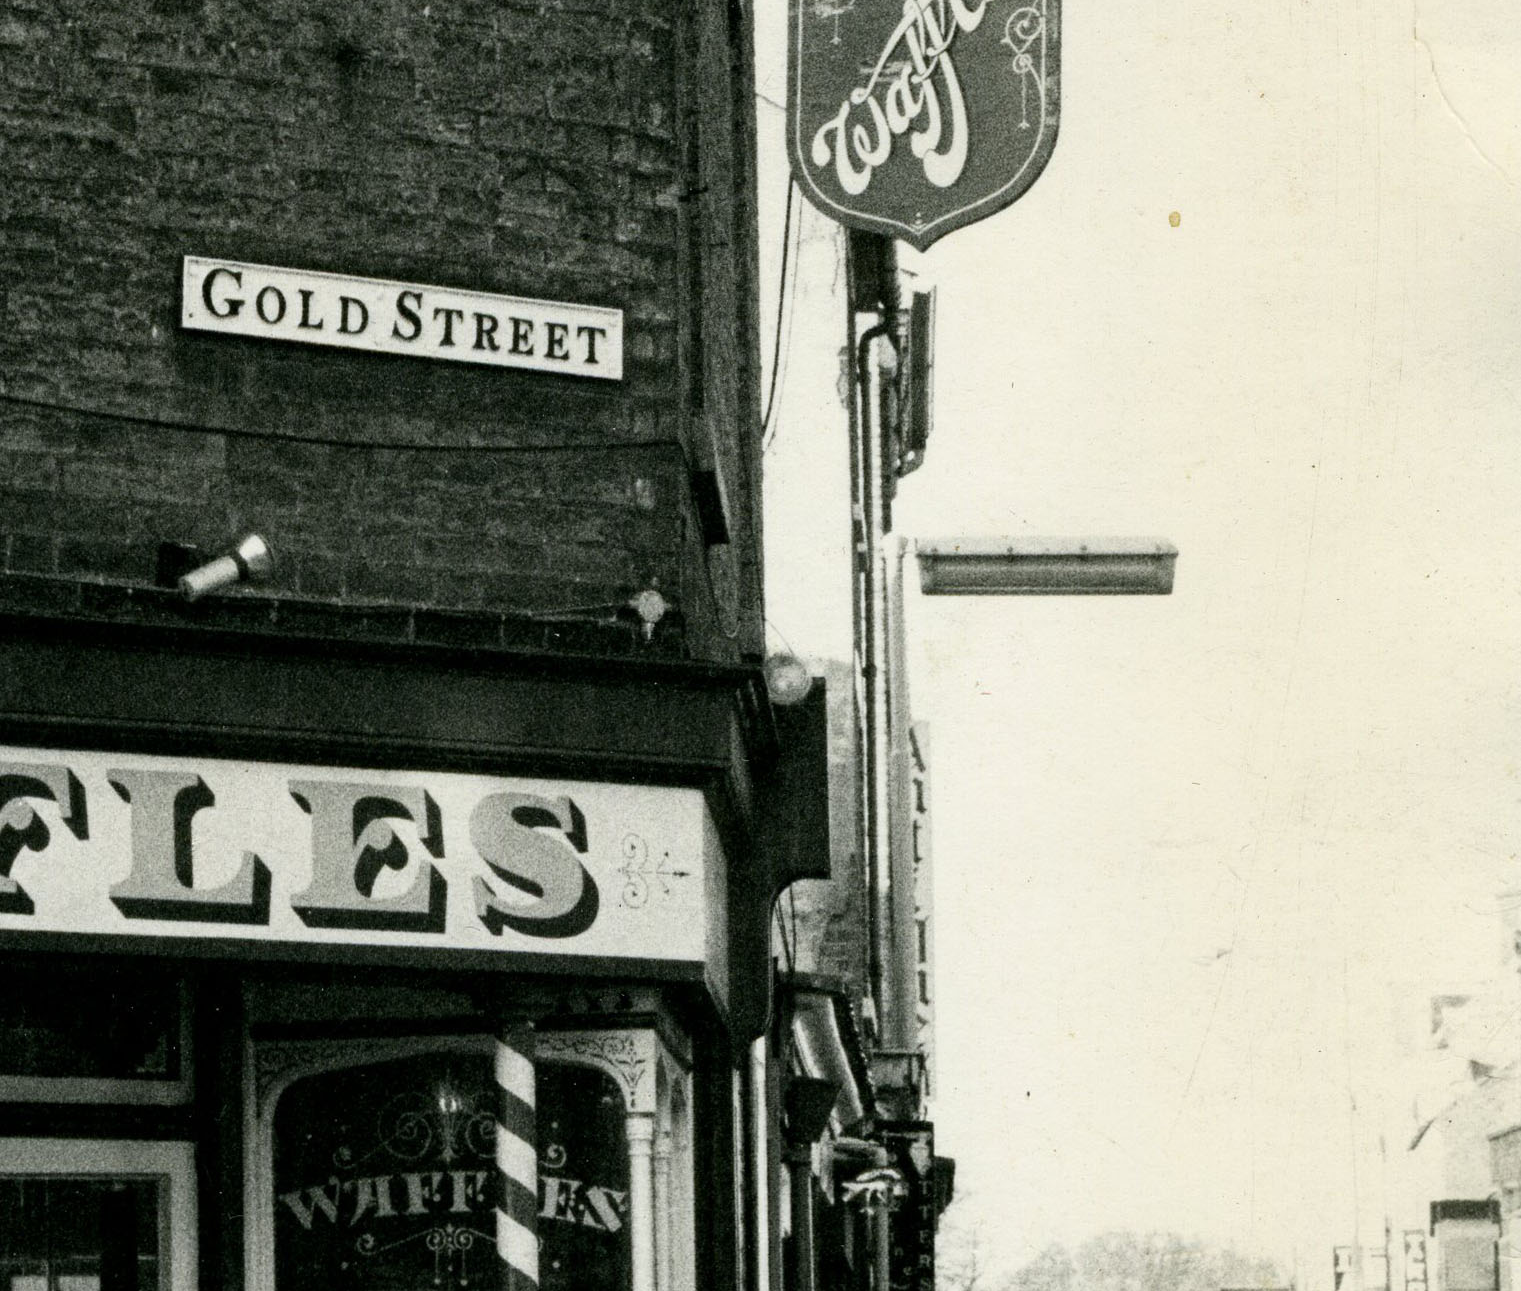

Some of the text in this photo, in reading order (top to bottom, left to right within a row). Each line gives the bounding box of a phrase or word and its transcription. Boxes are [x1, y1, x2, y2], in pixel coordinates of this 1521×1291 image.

[201, 268, 607, 365] GOLD STREET
[278, 1171, 629, 1234] WAFFES
